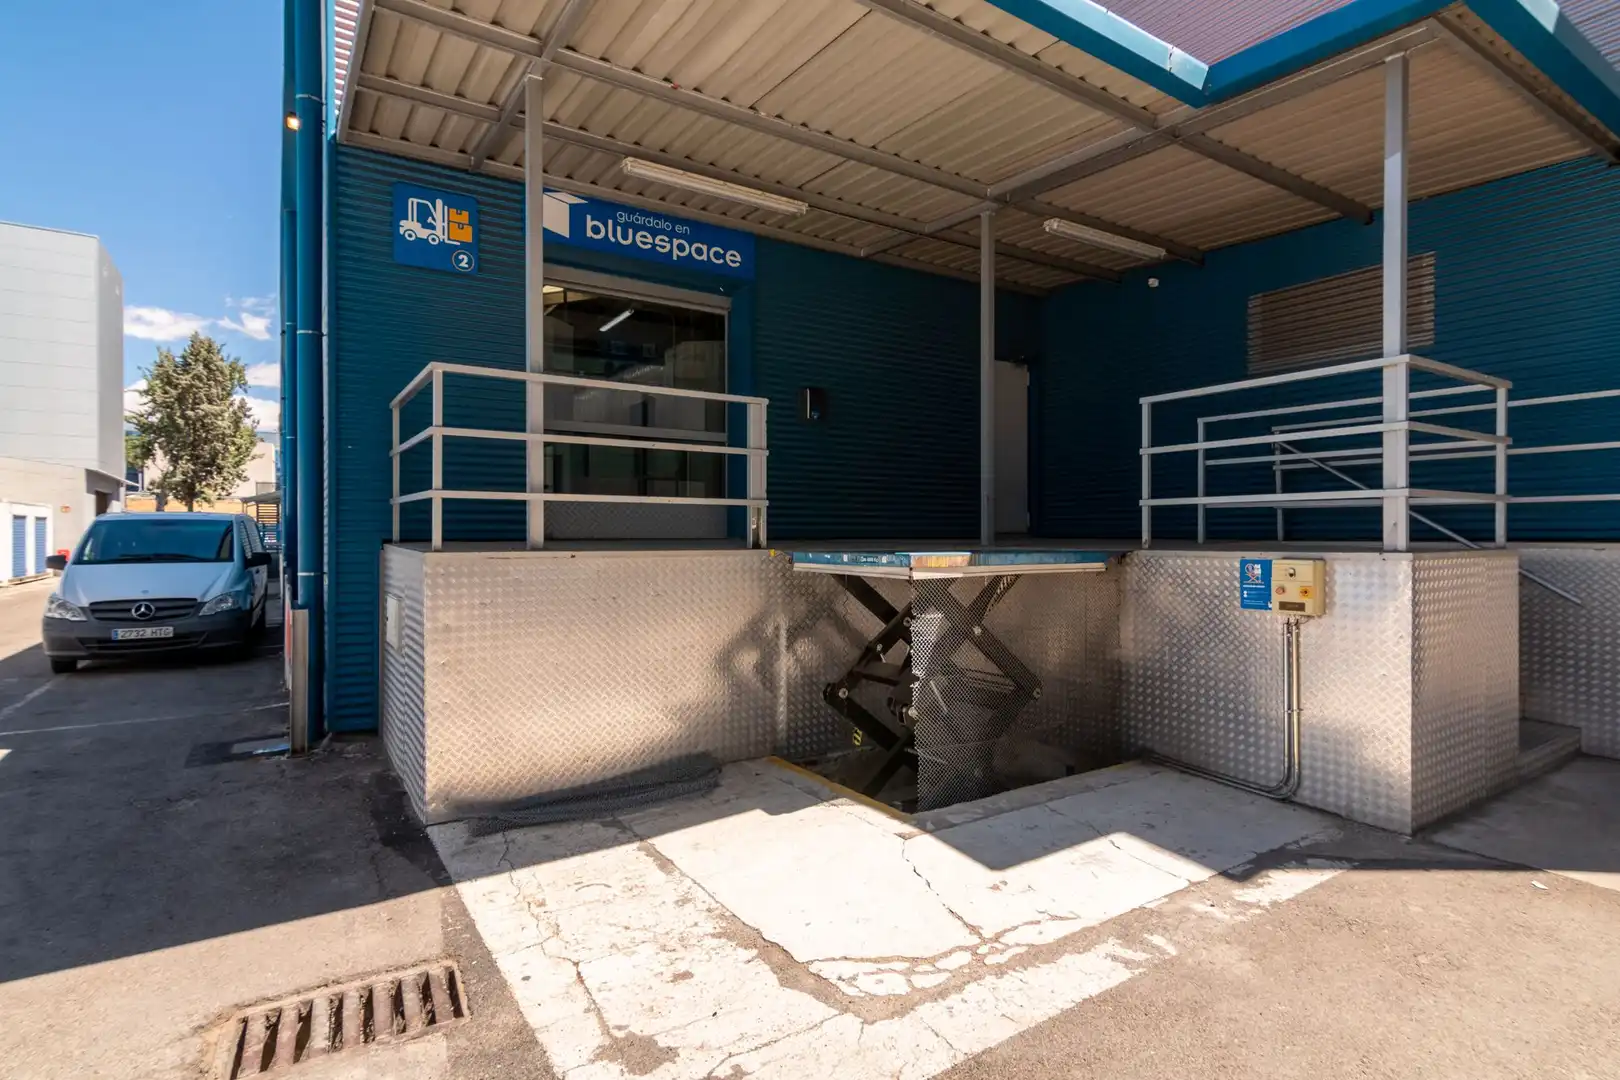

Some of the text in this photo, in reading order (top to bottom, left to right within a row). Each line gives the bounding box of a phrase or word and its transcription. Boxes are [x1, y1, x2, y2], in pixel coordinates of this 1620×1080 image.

[616, 210, 690, 235] guárdalo en
[586, 214, 742, 268] bluespace
[458, 254, 469, 268] 2
[120, 627, 172, 639] 2732 HTG
